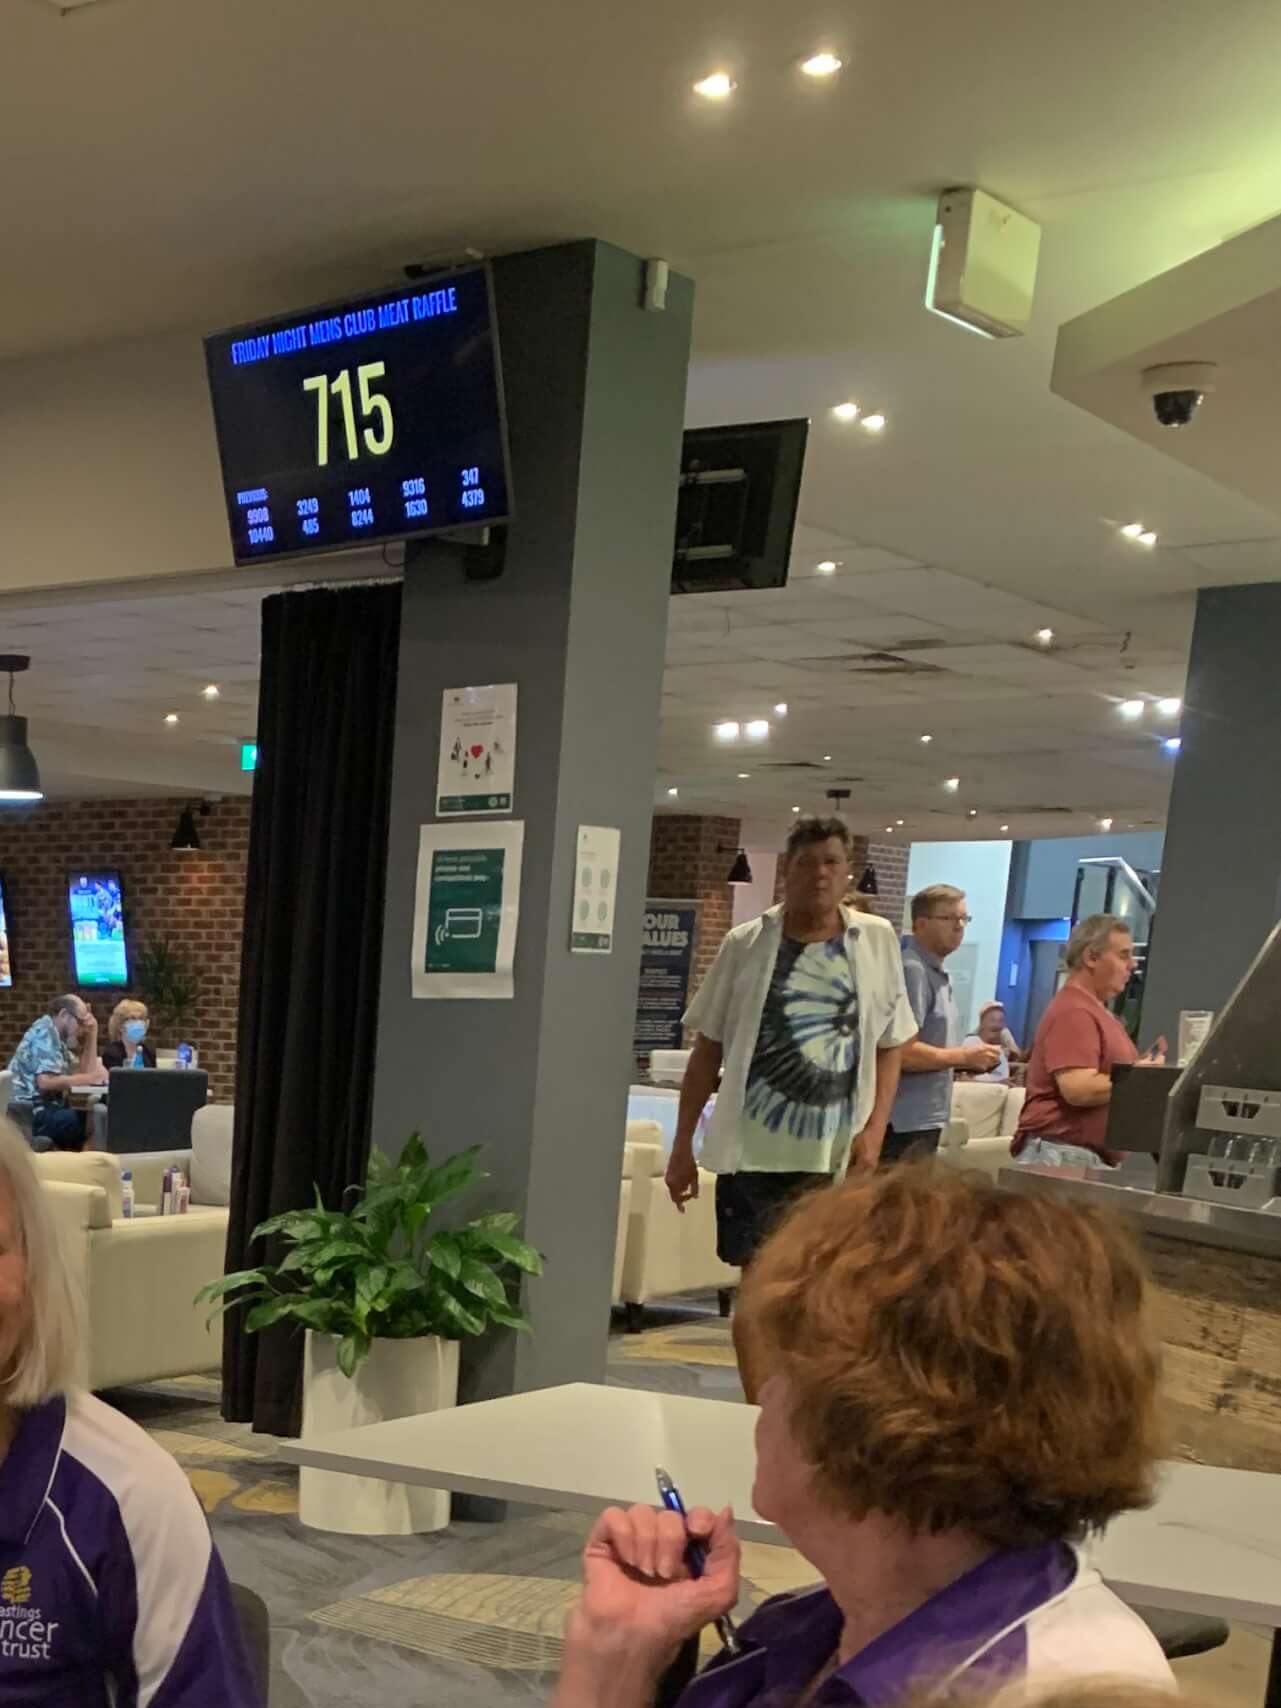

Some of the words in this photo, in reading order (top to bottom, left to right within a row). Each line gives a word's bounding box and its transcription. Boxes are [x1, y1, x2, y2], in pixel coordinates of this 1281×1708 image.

[231, 335, 270, 365] FRIDAY
[272, 326, 308, 355] NIGHT
[309, 318, 343, 346] MENS
[344, 309, 377, 335] CLUB
[378, 299, 410, 328] MEAT
[412, 287, 458, 321] RAFFLE
[303, 361, 394, 466] 715
[461, 467, 479, 487] 347
[348, 487, 371, 507] 1404
[461, 488, 485, 508] 4379
[641, 930, 689, 948] ALUES
[1, 1640, 52, 1659] trust
